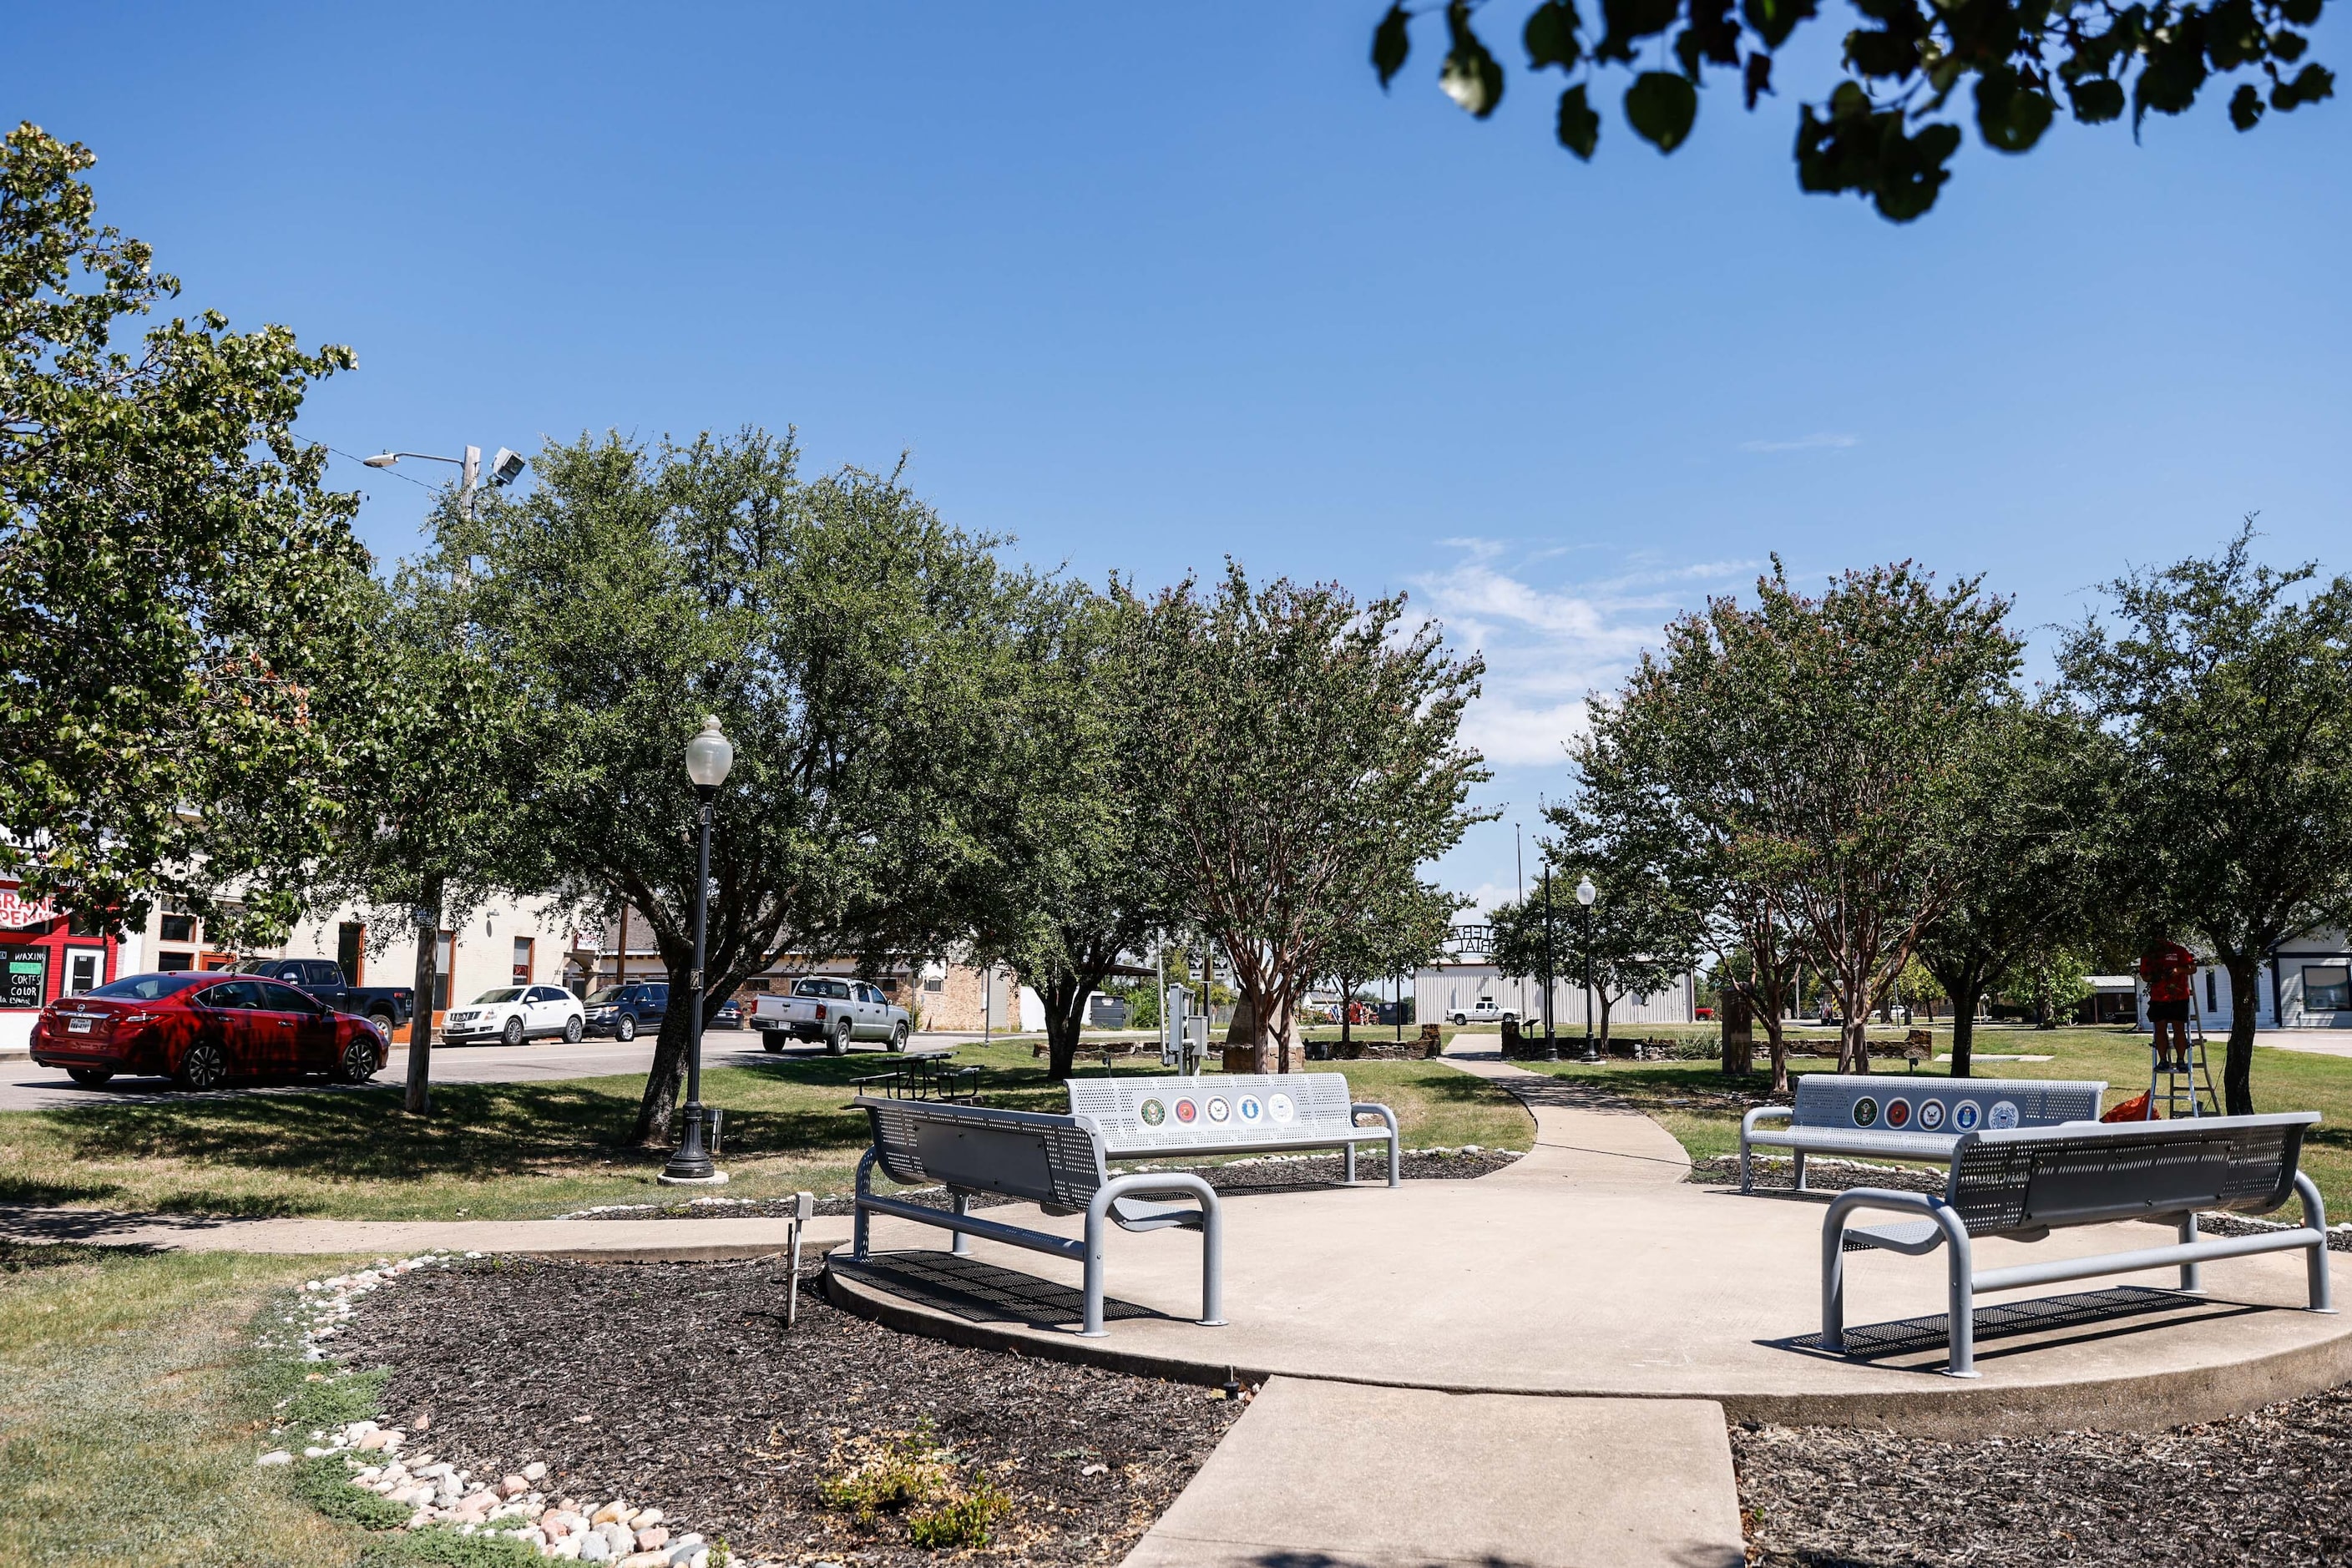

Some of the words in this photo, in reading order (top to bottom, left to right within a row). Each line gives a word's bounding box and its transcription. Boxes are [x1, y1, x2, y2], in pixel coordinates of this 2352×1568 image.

[14, 952, 47, 961] WAXING
[11, 974, 42, 986] CORTES
[10, 987, 37, 996] COLOR
